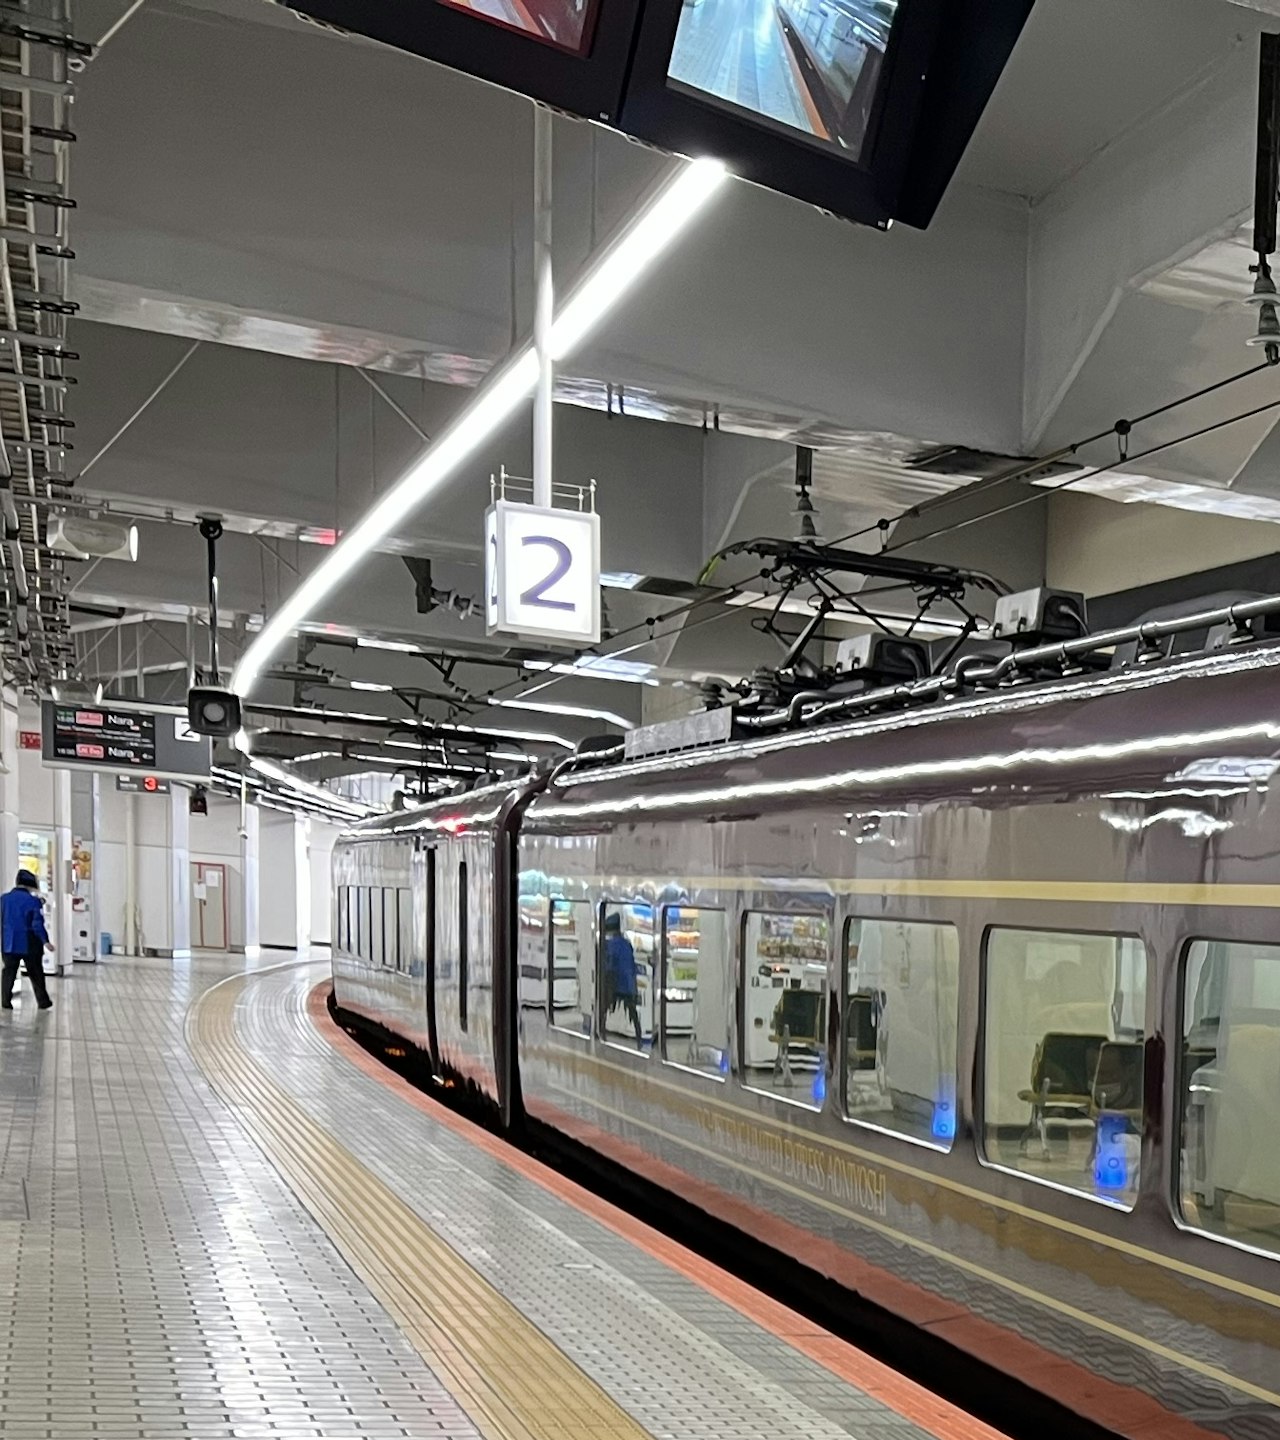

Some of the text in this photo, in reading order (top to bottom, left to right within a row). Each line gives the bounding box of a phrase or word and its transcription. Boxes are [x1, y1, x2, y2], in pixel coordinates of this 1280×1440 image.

[520, 535, 576, 612] 2
[108, 714, 134, 726] Nara
[108, 747, 134, 758] Nara
[144, 777, 157, 791] 3
[784, 1139, 826, 1191] EXPRESS
